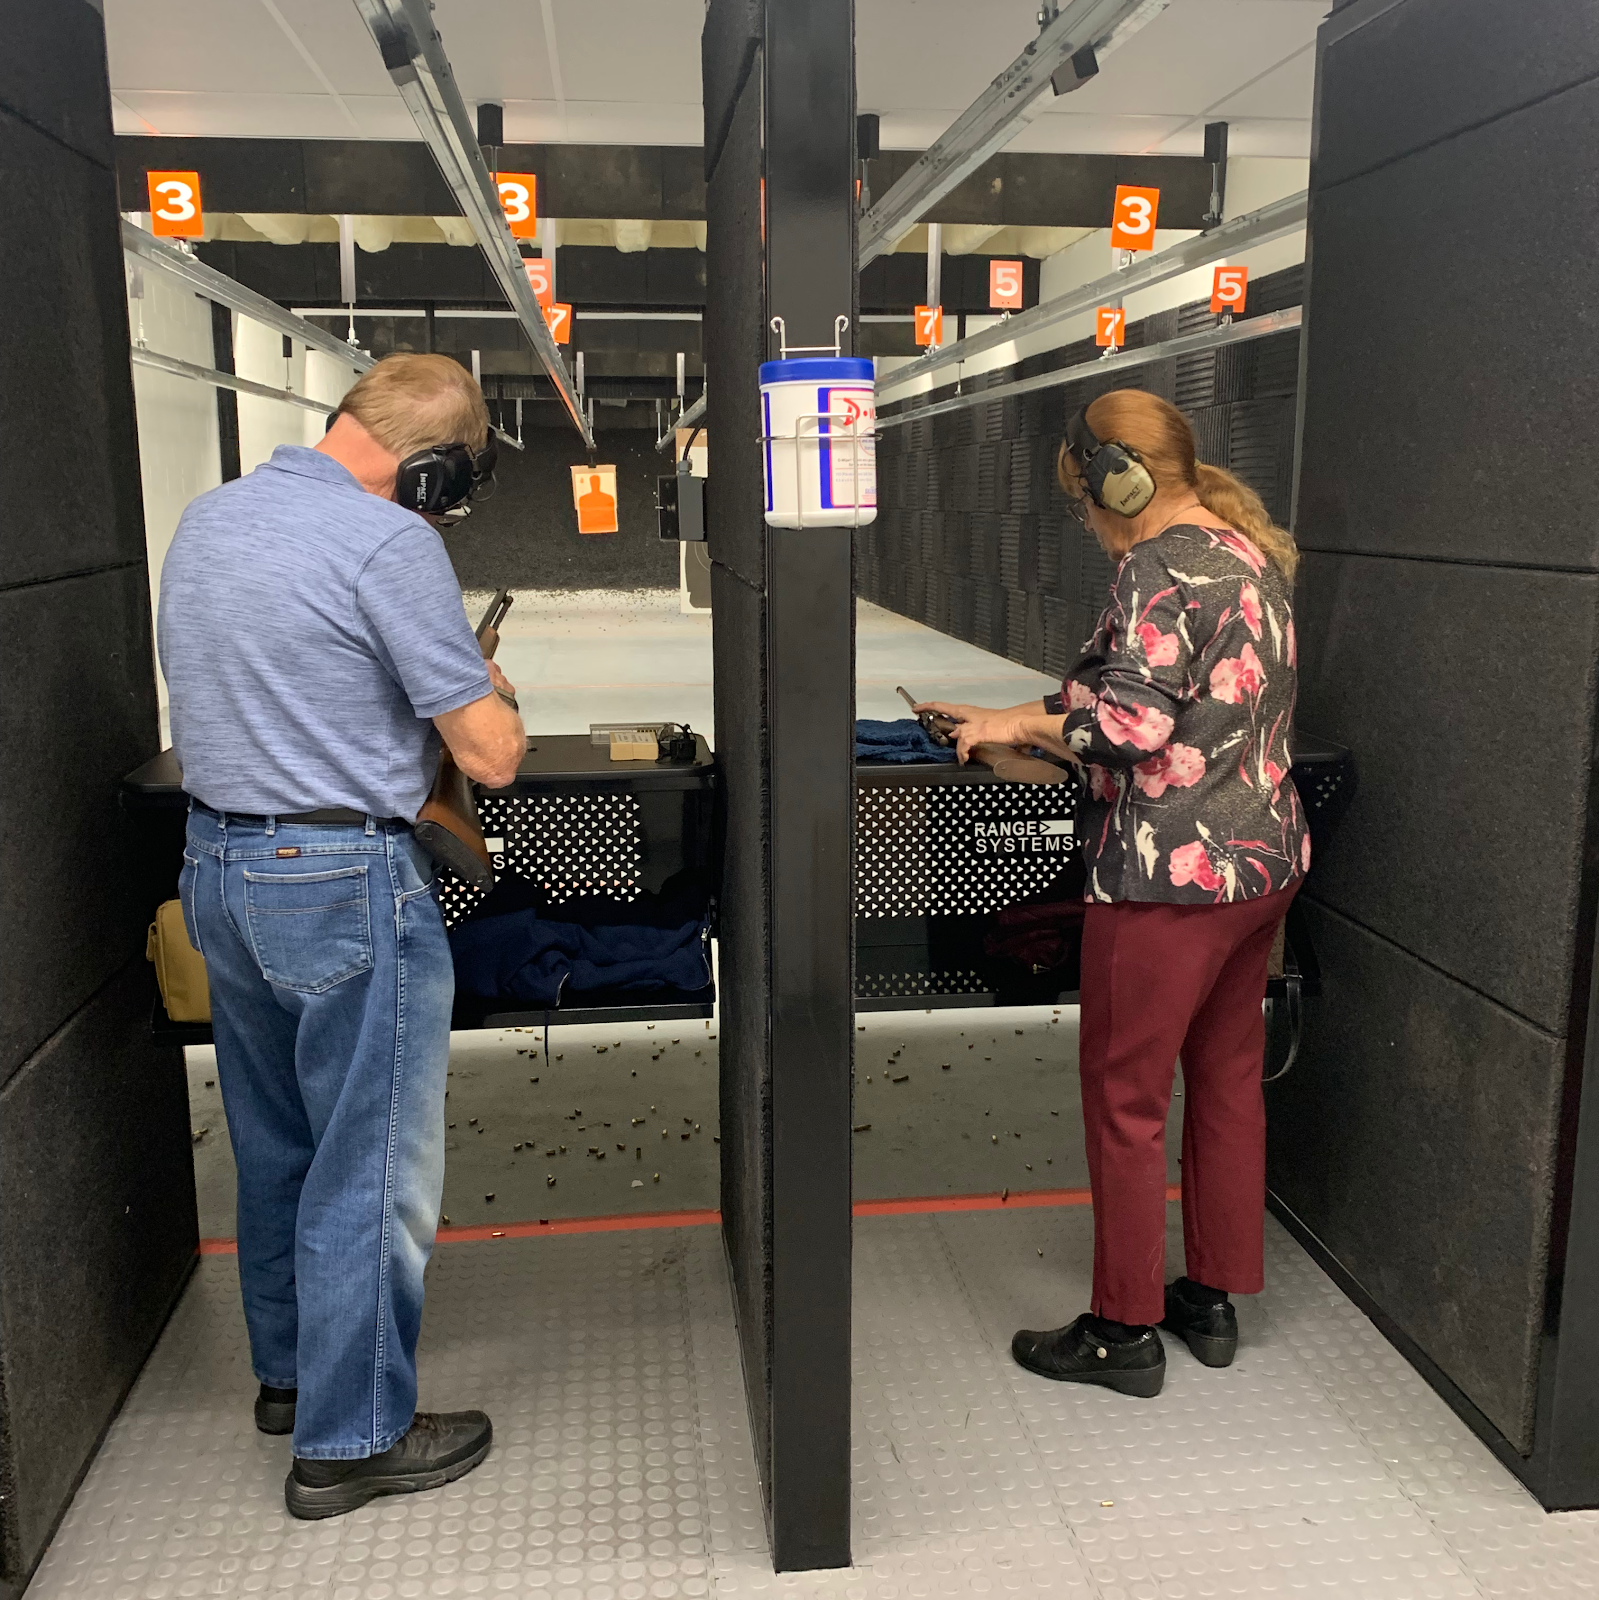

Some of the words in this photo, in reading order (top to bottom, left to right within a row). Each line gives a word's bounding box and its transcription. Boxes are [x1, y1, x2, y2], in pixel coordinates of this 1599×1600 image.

[155, 181, 195, 221] 3
[498, 182, 530, 222] 3
[1117, 196, 1152, 235] 3
[525, 265, 548, 295] 5
[995, 267, 1018, 297] 5
[1217, 272, 1242, 301] 5
[547, 308, 567, 333] 7
[920, 311, 938, 335] 7
[1102, 313, 1121, 337] 7
[974, 821, 1037, 837] RANGE
[975, 836, 1074, 853] SYSTEMS
